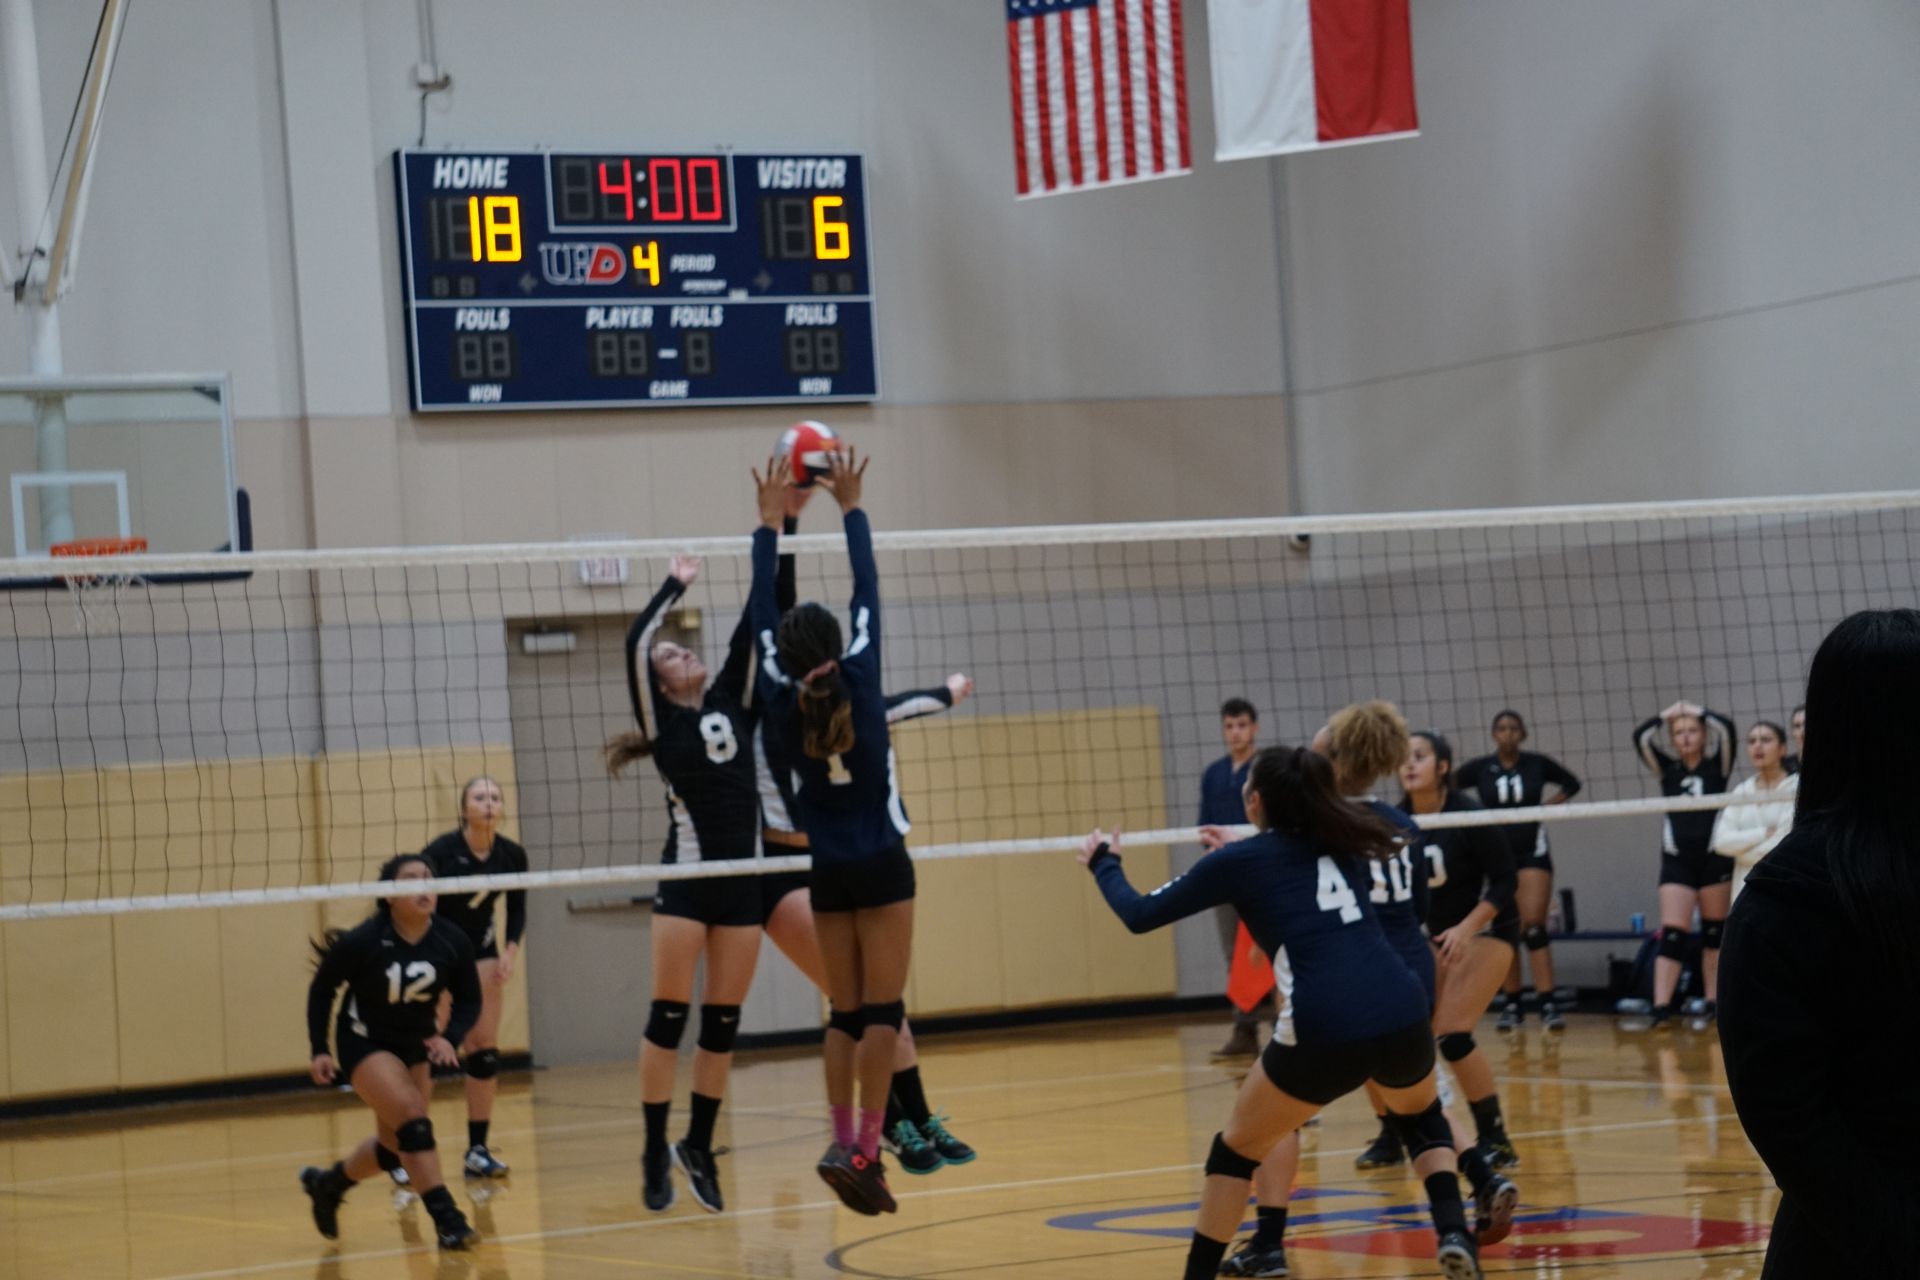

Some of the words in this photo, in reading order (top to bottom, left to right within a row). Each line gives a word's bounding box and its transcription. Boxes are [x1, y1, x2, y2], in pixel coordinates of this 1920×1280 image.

[433, 157, 509, 189] HOME
[757, 158, 847, 189] VISITOR
[599, 158, 722, 221] 4:00
[469, 196, 522, 262] 18
[813, 196, 850, 260] 6
[632, 241, 660, 286] 4
[670, 254, 716, 272] PERIOD
[455, 307, 511, 330] FOULS
[585, 306, 654, 329] PLAYER
[670, 305, 723, 327] FOULS
[785, 304, 838, 326] FOULS
[469, 384, 502, 402] WON
[649, 380, 689, 398] GAME
[799, 377, 832, 395] WON
[699, 711, 738, 765] 8
[1495, 774, 1523, 803] 11
[1368, 836, 1413, 904] 10
[1316, 855, 1363, 925] 4
[385, 960, 437, 1004] 12
